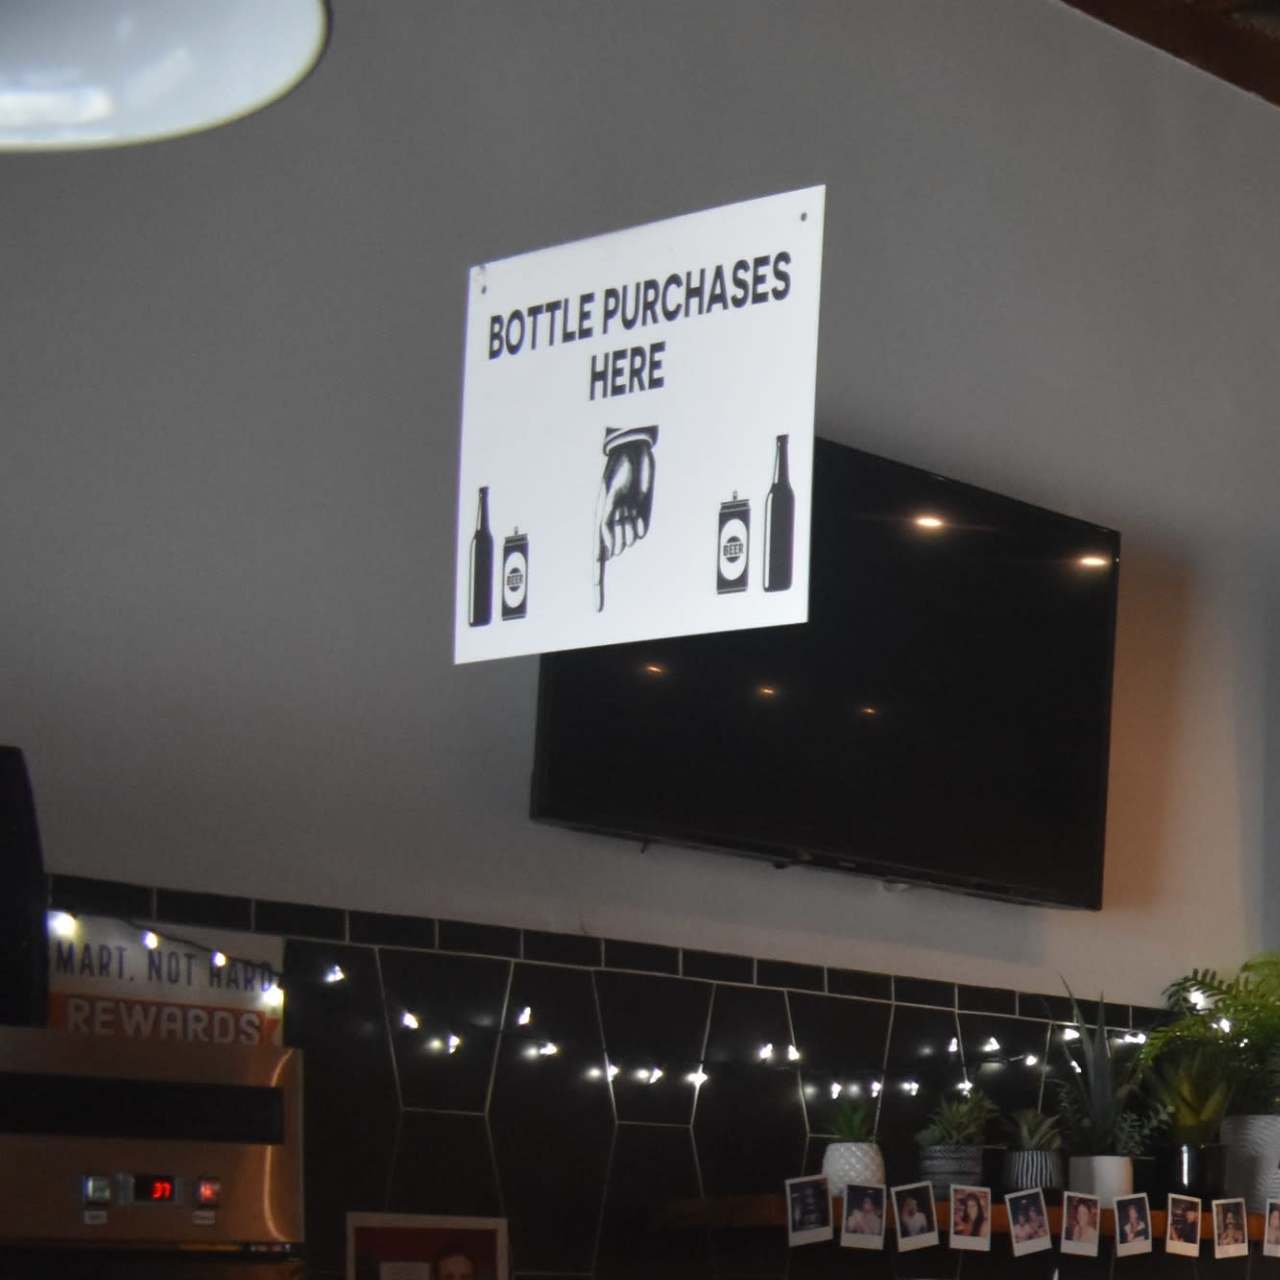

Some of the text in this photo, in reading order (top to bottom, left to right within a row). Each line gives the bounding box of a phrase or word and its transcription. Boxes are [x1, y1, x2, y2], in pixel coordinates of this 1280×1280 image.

[488, 251, 791, 360] BOTTLE PURCHASES
[590, 341, 666, 401] HERE
[723, 542, 744, 558] BEER
[56, 941, 136, 982] MART.
[147, 951, 196, 987] NOT
[66, 999, 260, 1046] REWARDS
